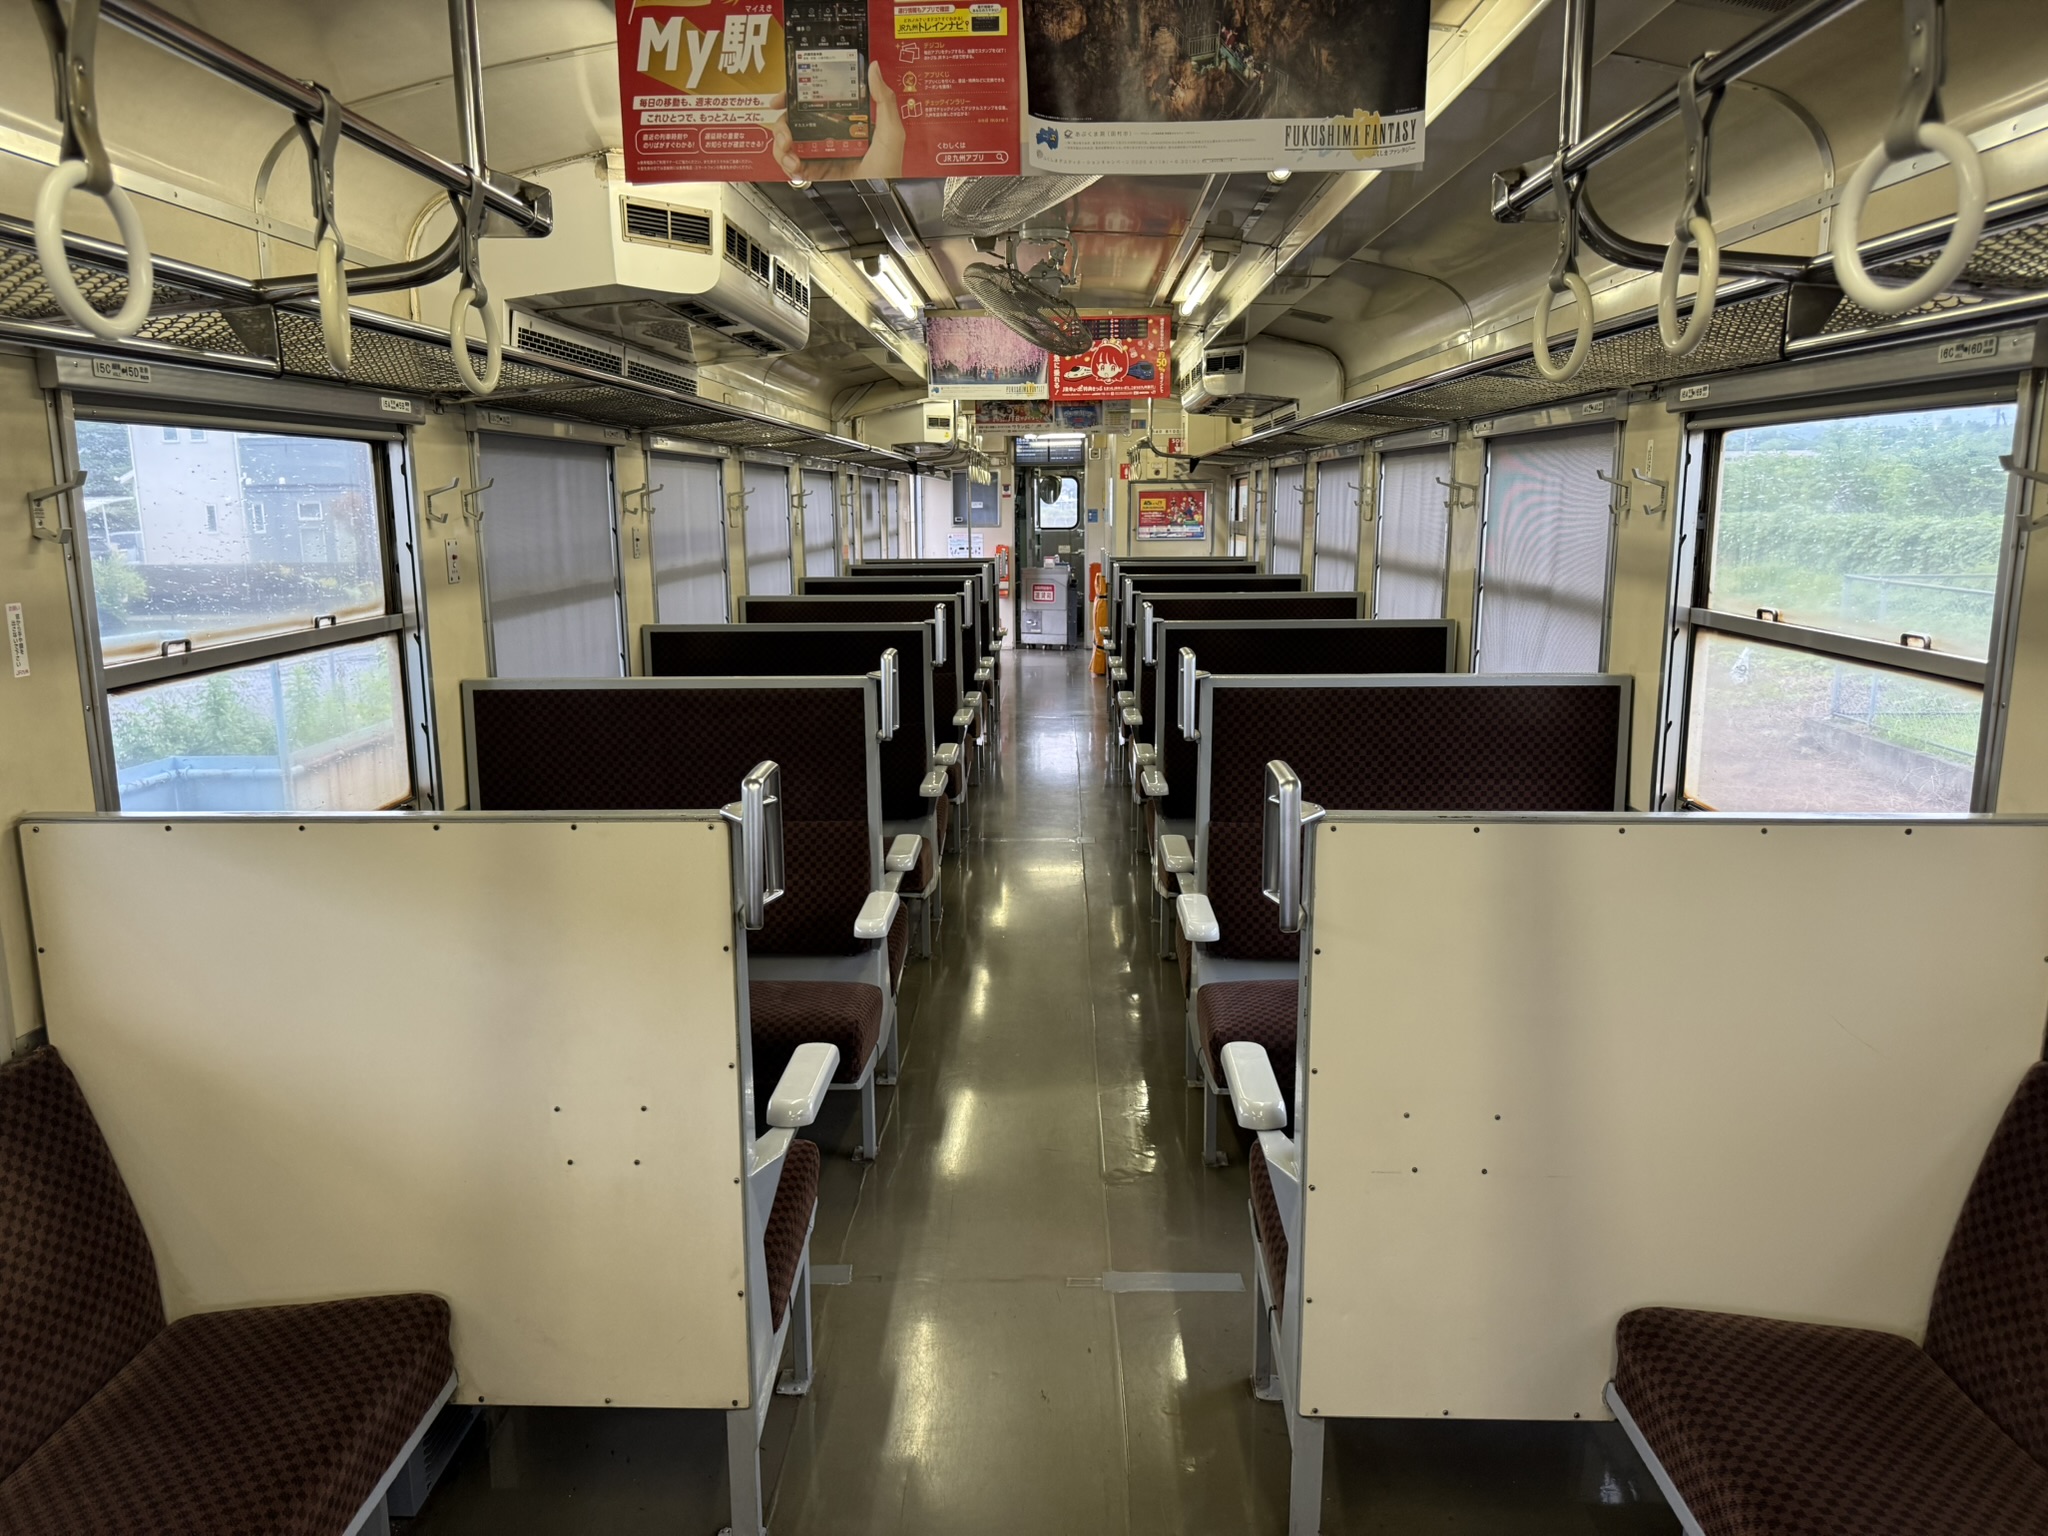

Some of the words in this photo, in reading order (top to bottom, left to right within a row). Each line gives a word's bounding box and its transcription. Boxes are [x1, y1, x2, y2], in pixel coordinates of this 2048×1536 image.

[898, 6, 950, 14] 運行情報もアプリで確認
[636, 14, 773, 89] My駅
[639, 97, 765, 108] 毎日の移動も、週末のおでかけも。
[647, 113, 765, 123] これひとつで、もっとスムーズに。
[1284, 124, 1359, 147] FUKUSHIMA
[1364, 119, 1417, 146] FANTASY
[944, 154, 984, 162] JR九州アプリ
[96, 362, 111, 374] 15C
